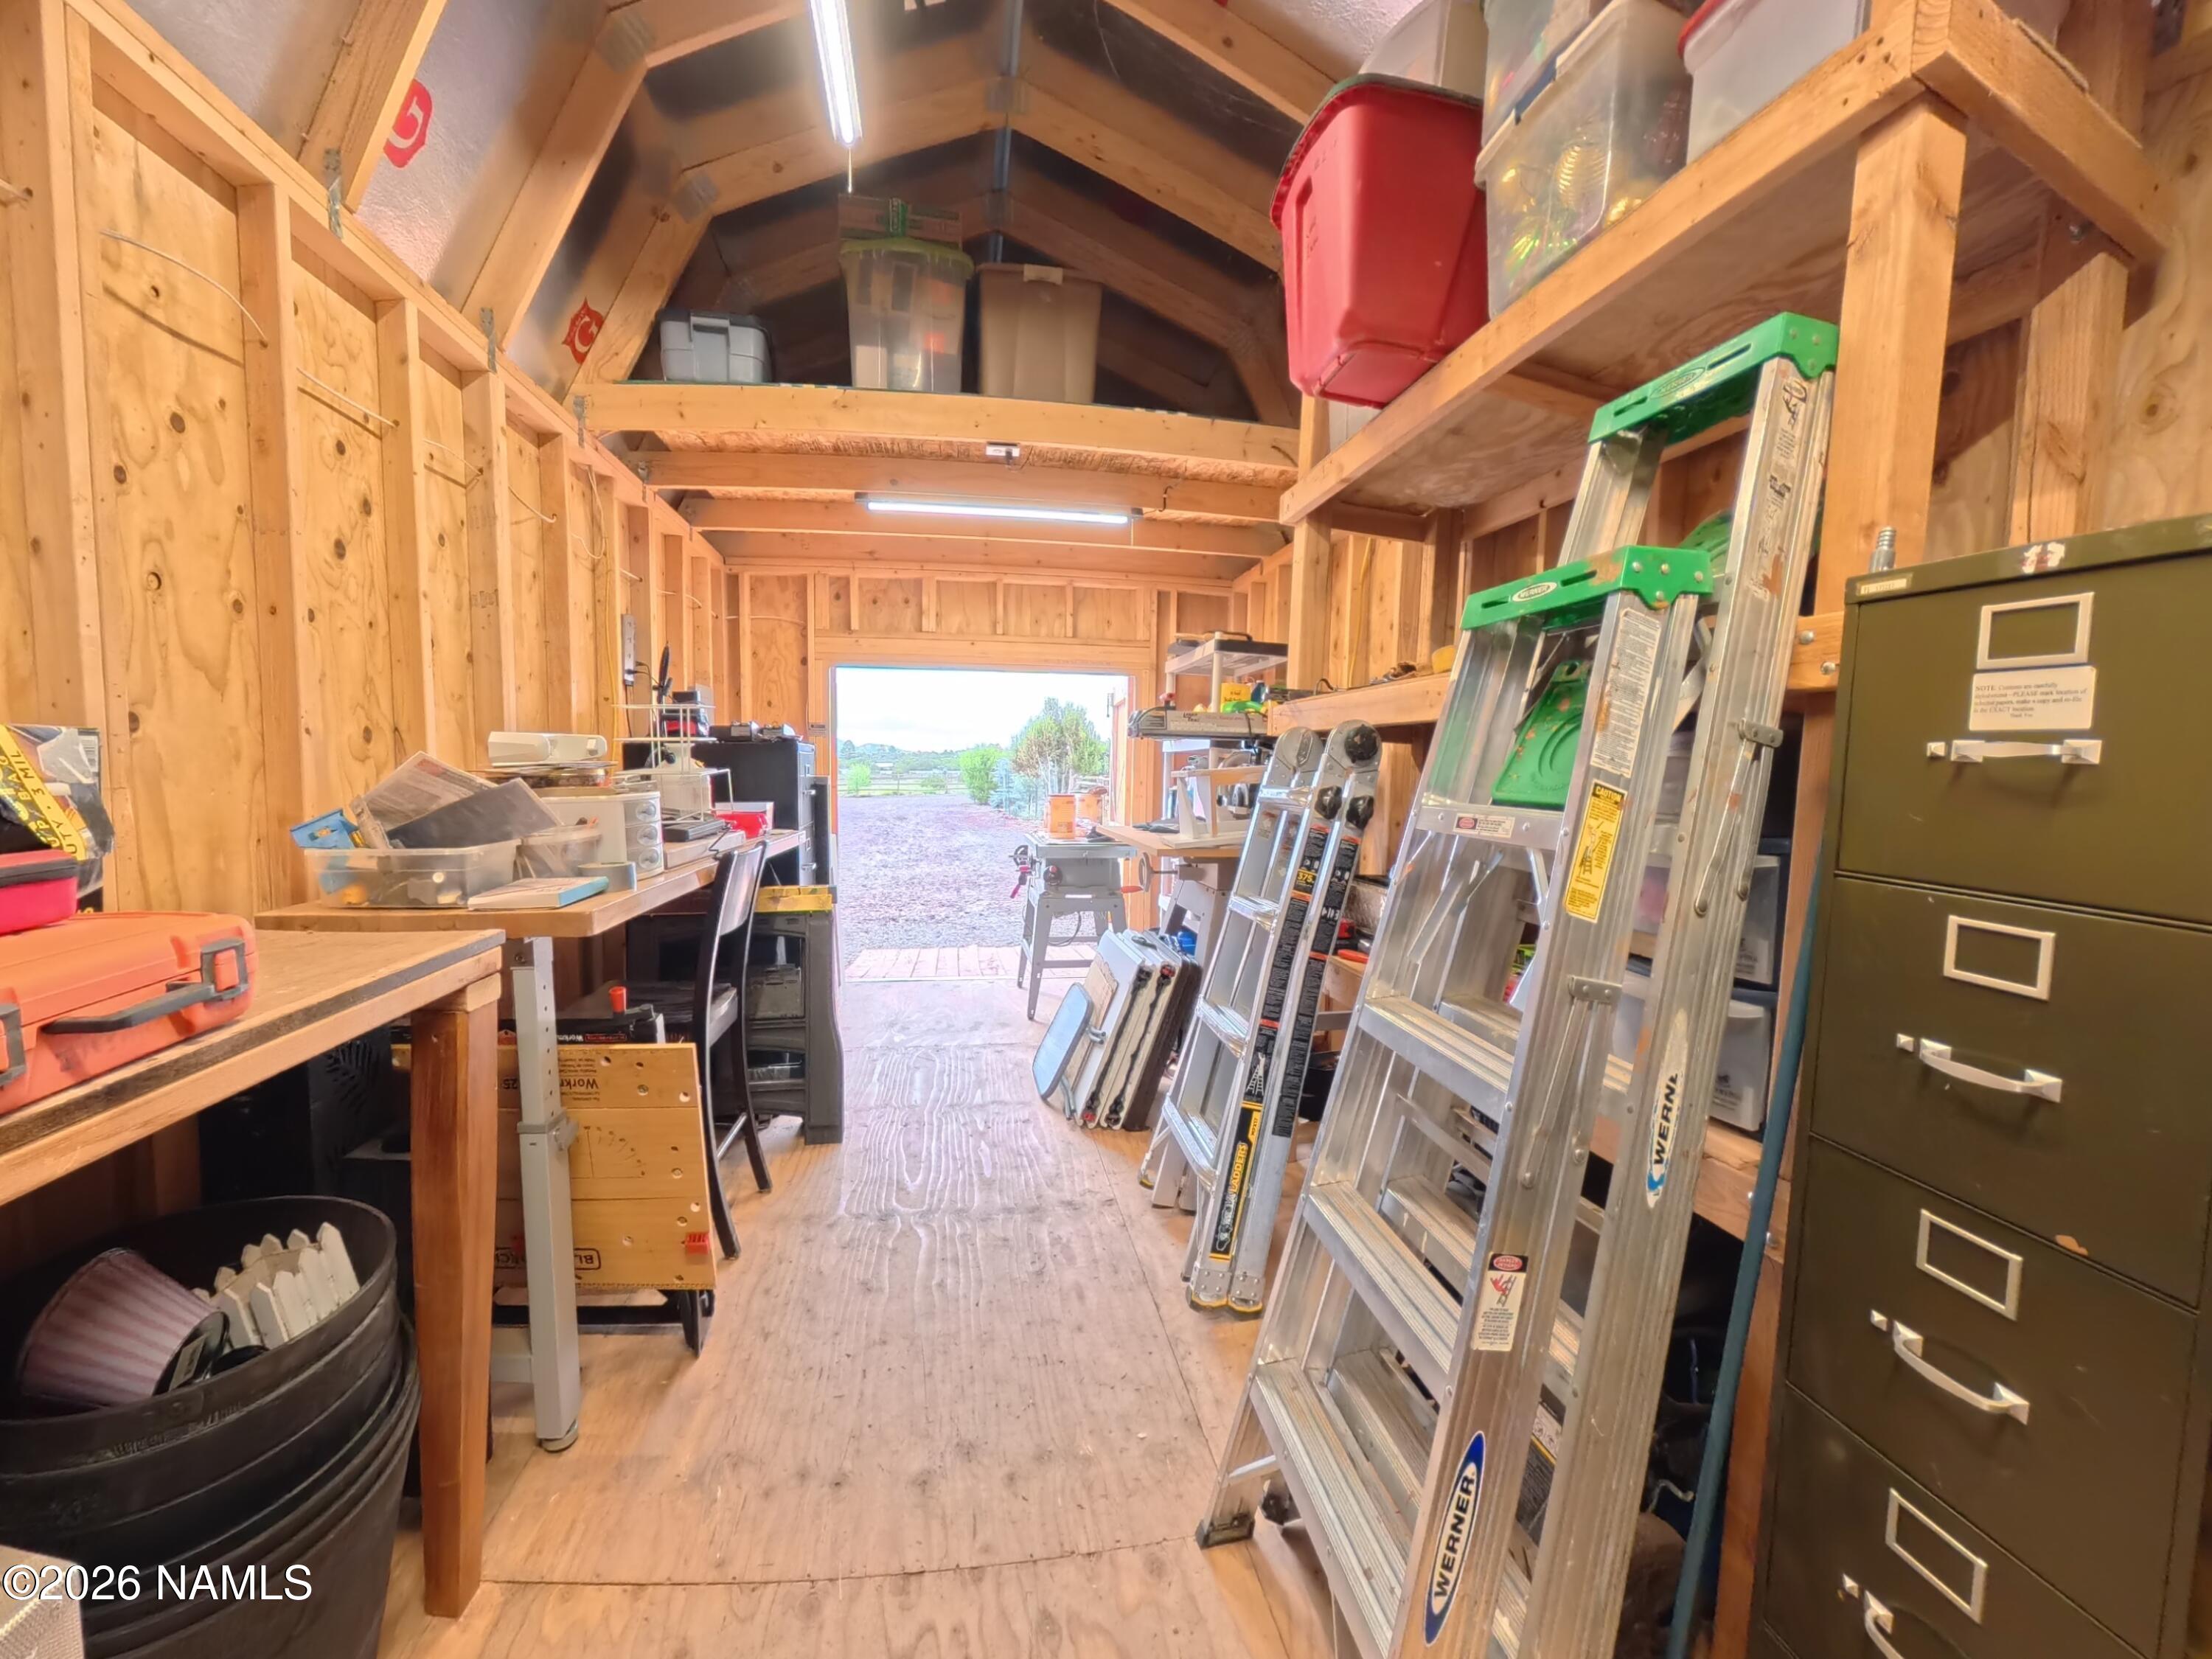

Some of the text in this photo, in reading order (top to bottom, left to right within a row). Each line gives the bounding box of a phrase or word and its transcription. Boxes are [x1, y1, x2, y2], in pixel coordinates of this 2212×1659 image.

[10, 751, 35, 779] MIL
[1230, 1144, 1248, 1194] LADDERS
[1434, 1473, 1475, 1598] WERNER
